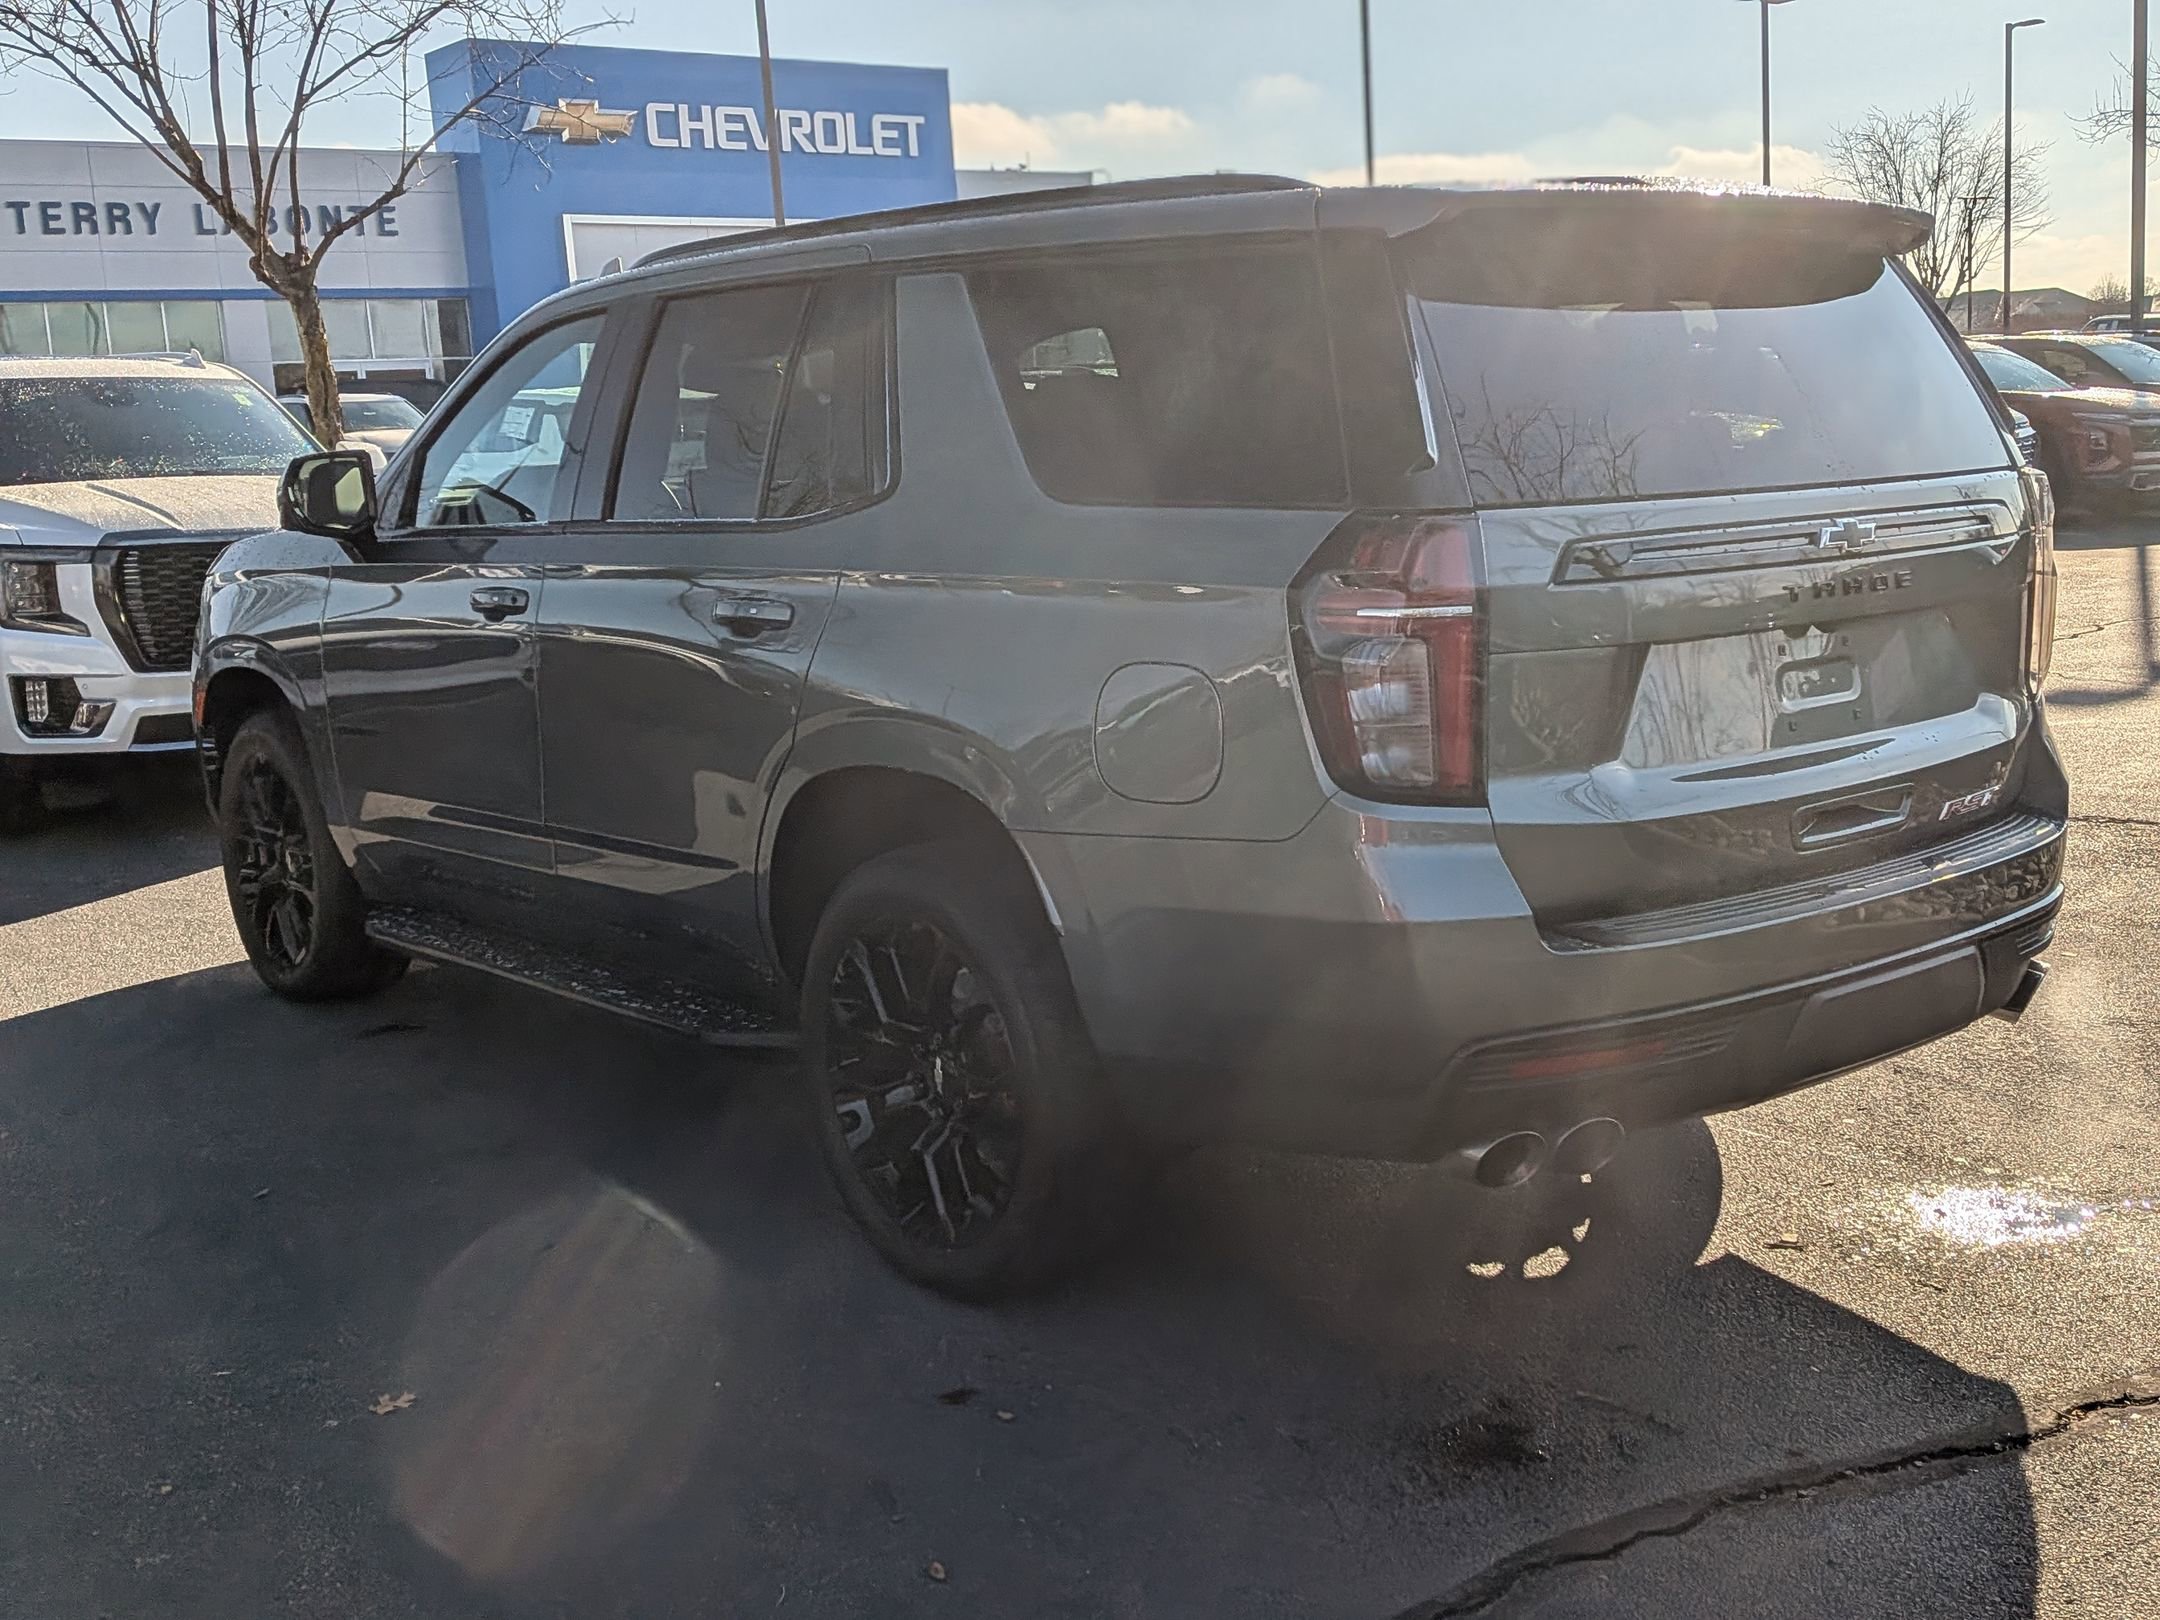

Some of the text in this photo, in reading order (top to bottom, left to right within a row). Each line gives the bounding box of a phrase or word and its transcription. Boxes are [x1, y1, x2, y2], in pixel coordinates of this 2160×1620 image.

[645, 102, 925, 157] CHEVROLET
[5, 201, 399, 236] TERRY LBONTE
[1782, 570, 1913, 602] TAHOE
